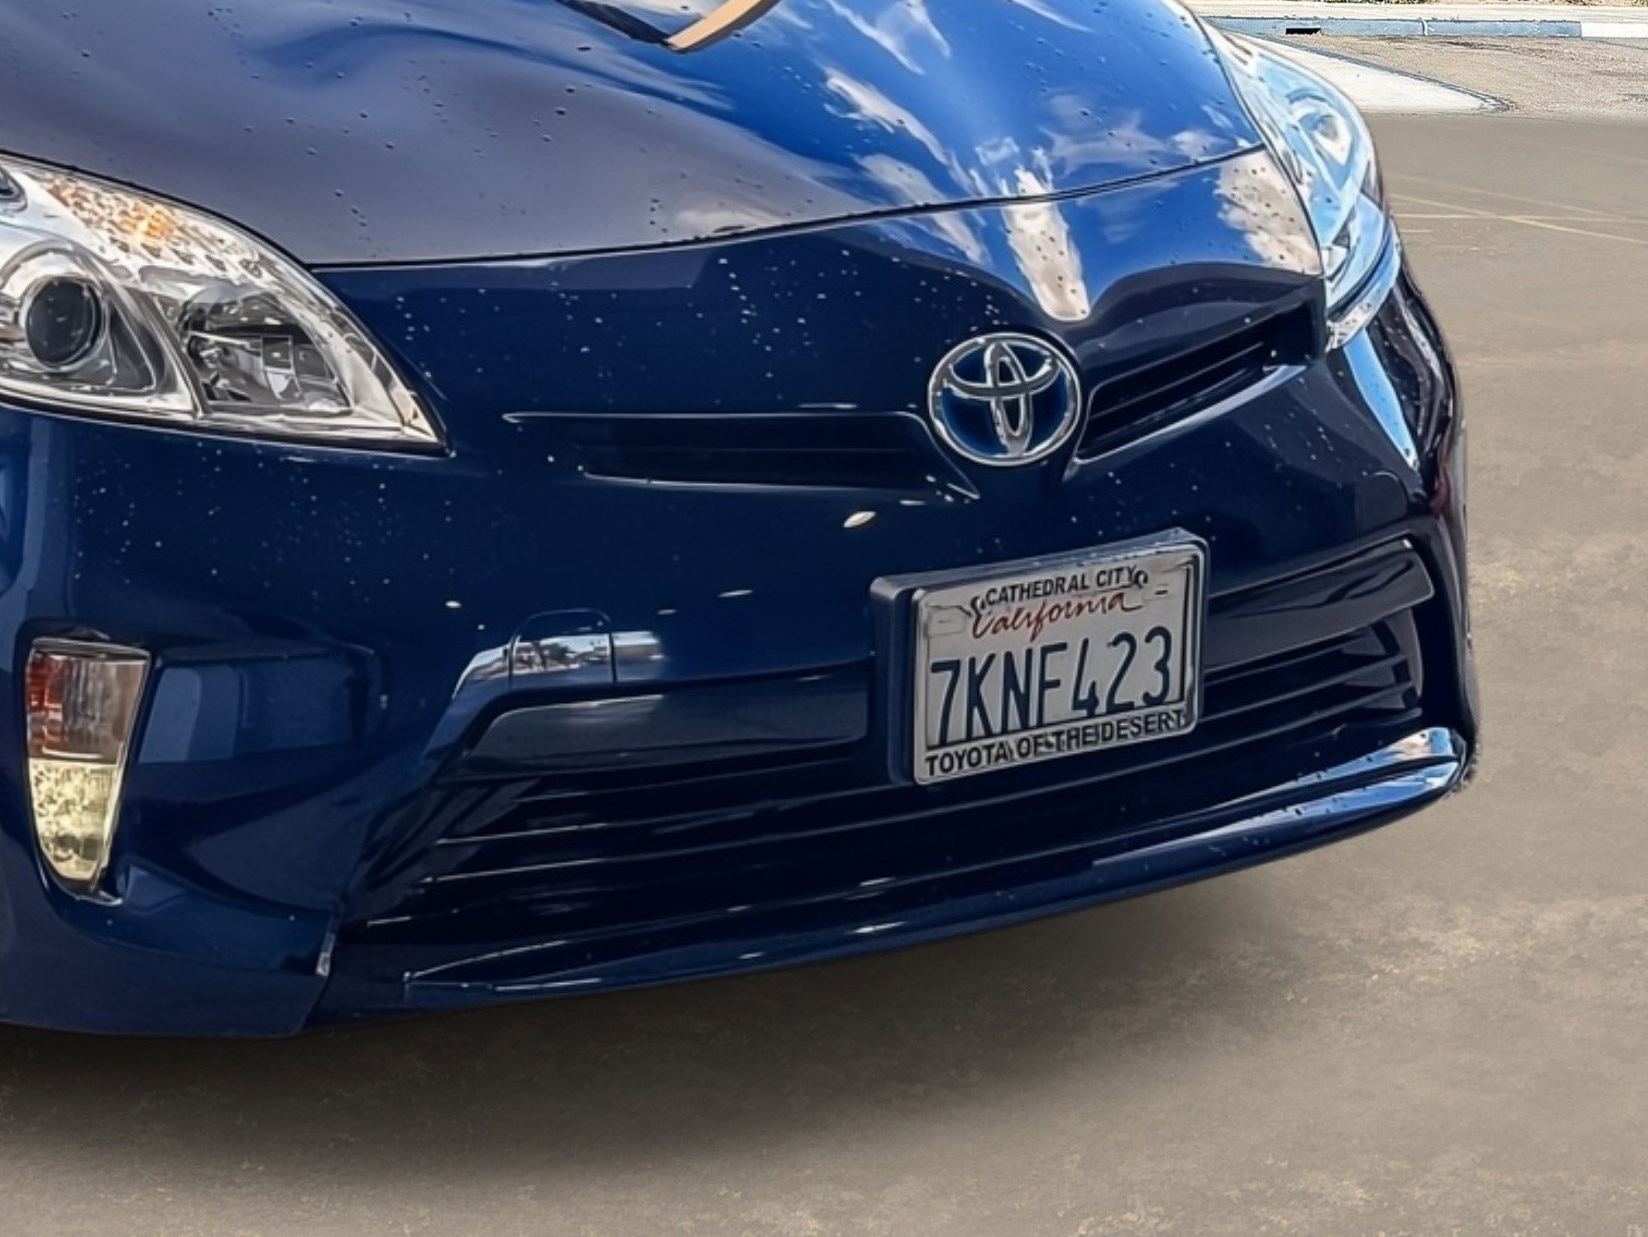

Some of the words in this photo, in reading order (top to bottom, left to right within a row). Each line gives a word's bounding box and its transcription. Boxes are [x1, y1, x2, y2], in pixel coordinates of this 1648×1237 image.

[985, 572, 1090, 606] CATHEDRAL
[1096, 565, 1137, 588] CITY
[970, 592, 1144, 642] California
[929, 626, 1173, 747] 7KNF423
[925, 744, 1012, 777] TOYOTA
[1016, 736, 1047, 759] OF
[1104, 709, 1187, 742] DESERT
